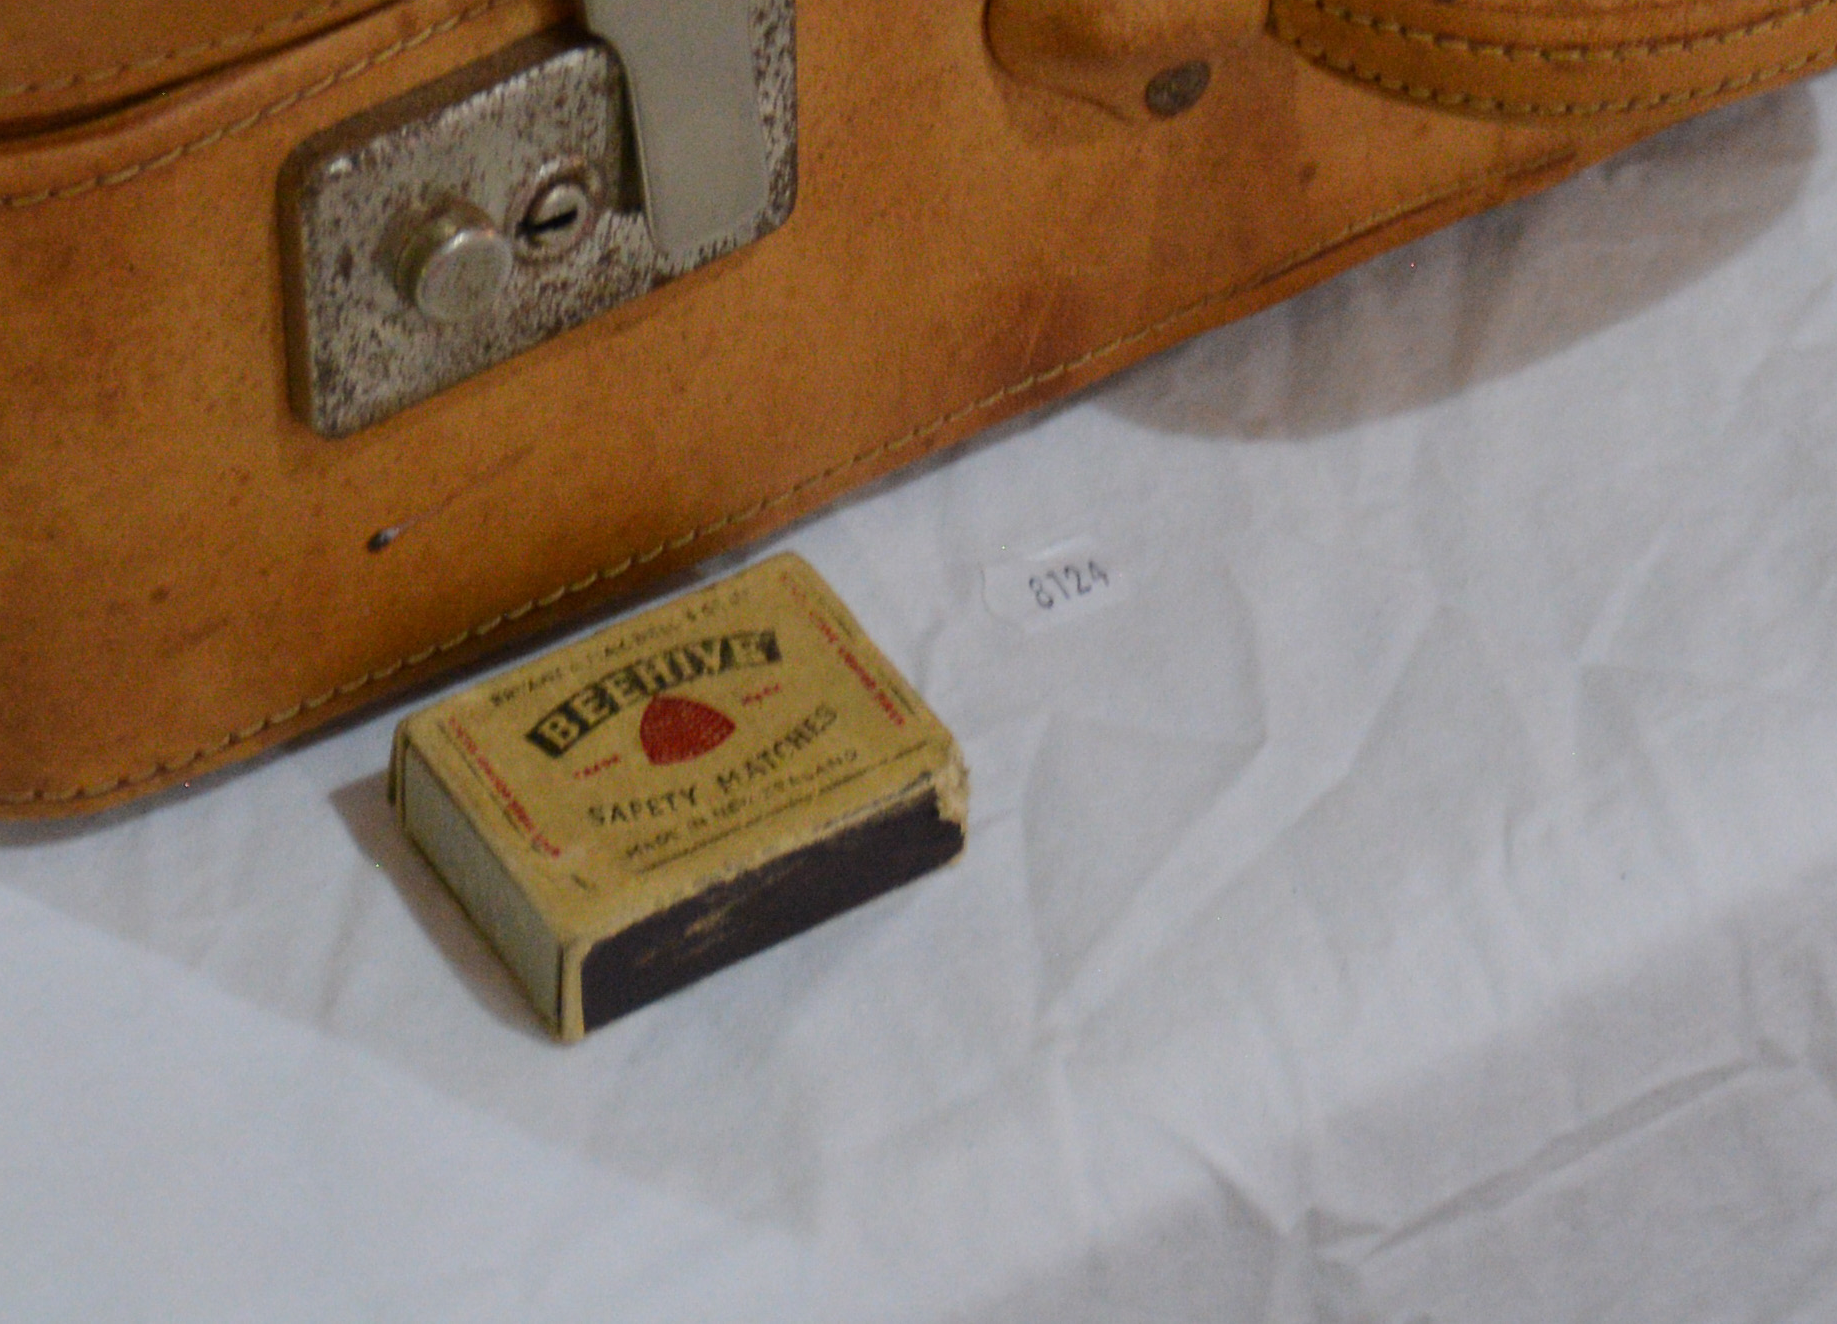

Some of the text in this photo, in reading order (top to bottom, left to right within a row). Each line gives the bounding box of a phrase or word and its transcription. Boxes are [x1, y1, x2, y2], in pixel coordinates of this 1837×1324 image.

[1028, 559, 1110, 610] 8124
[533, 630, 769, 753] BEEHIVE
[587, 783, 700, 827] SAFETY
[715, 703, 839, 795] MATCHES
